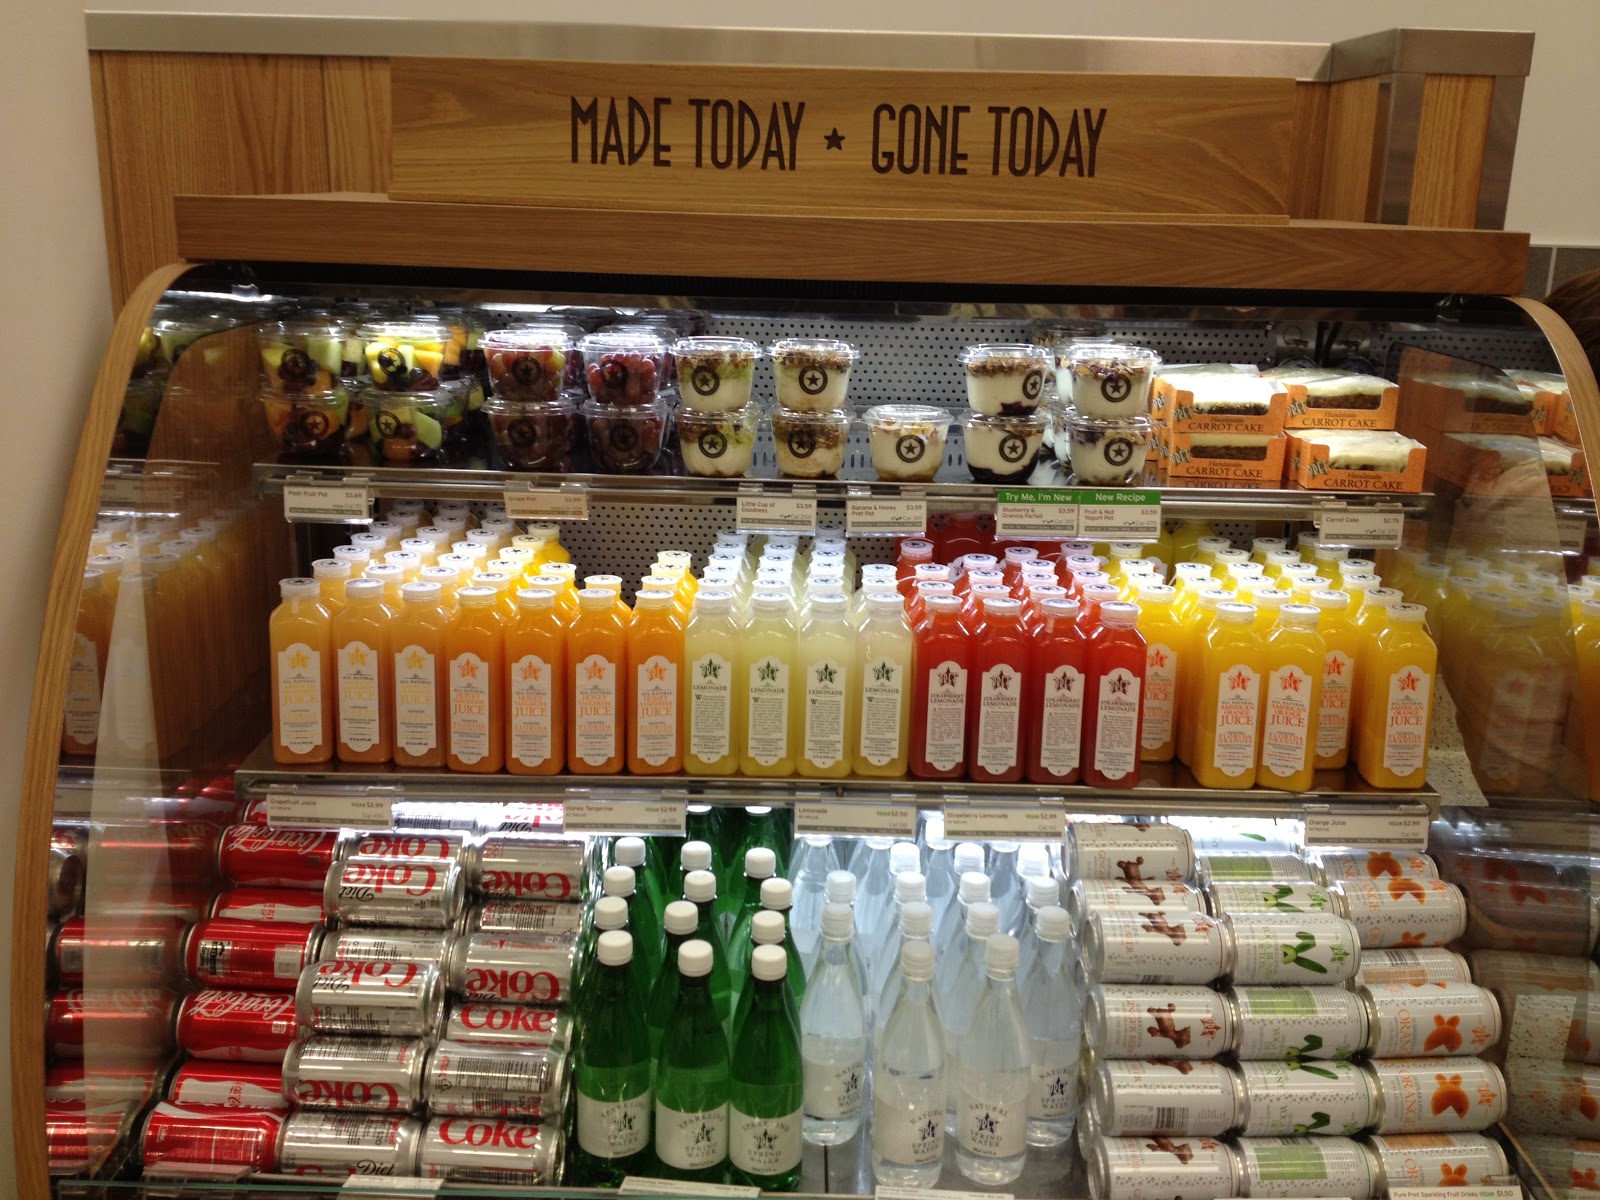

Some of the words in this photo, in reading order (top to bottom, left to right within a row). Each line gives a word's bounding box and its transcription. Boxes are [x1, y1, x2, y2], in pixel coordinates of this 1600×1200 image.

[570, 96, 672, 167] MADE
[689, 98, 806, 171] TODAY
[872, 103, 970, 175] GONE
[988, 106, 1108, 178] TODAY
[1188, 422, 1234, 432] CARROT
[1235, 423, 1264, 432] CAKE
[1302, 417, 1347, 427] CARROT
[1348, 419, 1377, 428] CAKE
[1186, 466, 1232, 476] CARROT
[1233, 469, 1263, 478] CAKE
[1324, 478, 1370, 489] CARROT
[1373, 480, 1403, 490] CAKE
[1005, 492, 1019, 502] Try
[1021, 493, 1036, 501] Me,
[1038, 493, 1051, 501] I'm
[1095, 493, 1114, 501] New
[1116, 493, 1146, 502] Recipe
[757, 501, 769, 509] Cup
[1100, 705, 1136, 713] LEMONADE
[1272, 704, 1307, 712] AMERICAN
[1321, 699, 1346, 708] UICE
[453, 704, 486, 715] JUICE
[515, 706, 547, 717] JUICE
[579, 706, 612, 717] JUICE
[641, 707, 672, 717] JUICE
[1220, 715, 1254, 727] JUICE
[1270, 715, 1305, 727] JUICE
[1389, 716, 1423, 727] JUICE
[359, 837, 450, 859] Coke
[342, 863, 437, 897] Coke
[482, 869, 571, 898] Coke
[338, 885, 375, 902] Diet
[319, 960, 419, 988] Coke
[312, 977, 350, 994] Diet
[466, 968, 560, 1001] Coke
[187, 990, 296, 1020] Coca-Cola
[461, 1004, 556, 1033] Coke
[1126, 997, 1136, 1032] GINGER
[299, 1079, 398, 1111] Coke
[1398, 1069, 1417, 1127] ORANGE
[968, 1103, 1008, 1118] NATURAL
[1041, 1101, 1068, 1110] WATER
[438, 1118, 540, 1149] Coke
[969, 1130, 1003, 1142] SPRING
[609, 1137, 638, 1148] WATER
[684, 1142, 718, 1152] SPRING
[971, 1138, 1000, 1148] WATER
[686, 1149, 717, 1159] WATER
[748, 1150, 782, 1158] SPRING
[913, 1146, 939, 1156] WATER
[749, 1157, 780, 1165] WATER
[356, 1159, 396, 1176] Diet
[1496, 1190, 1514, 1198] $1.50
